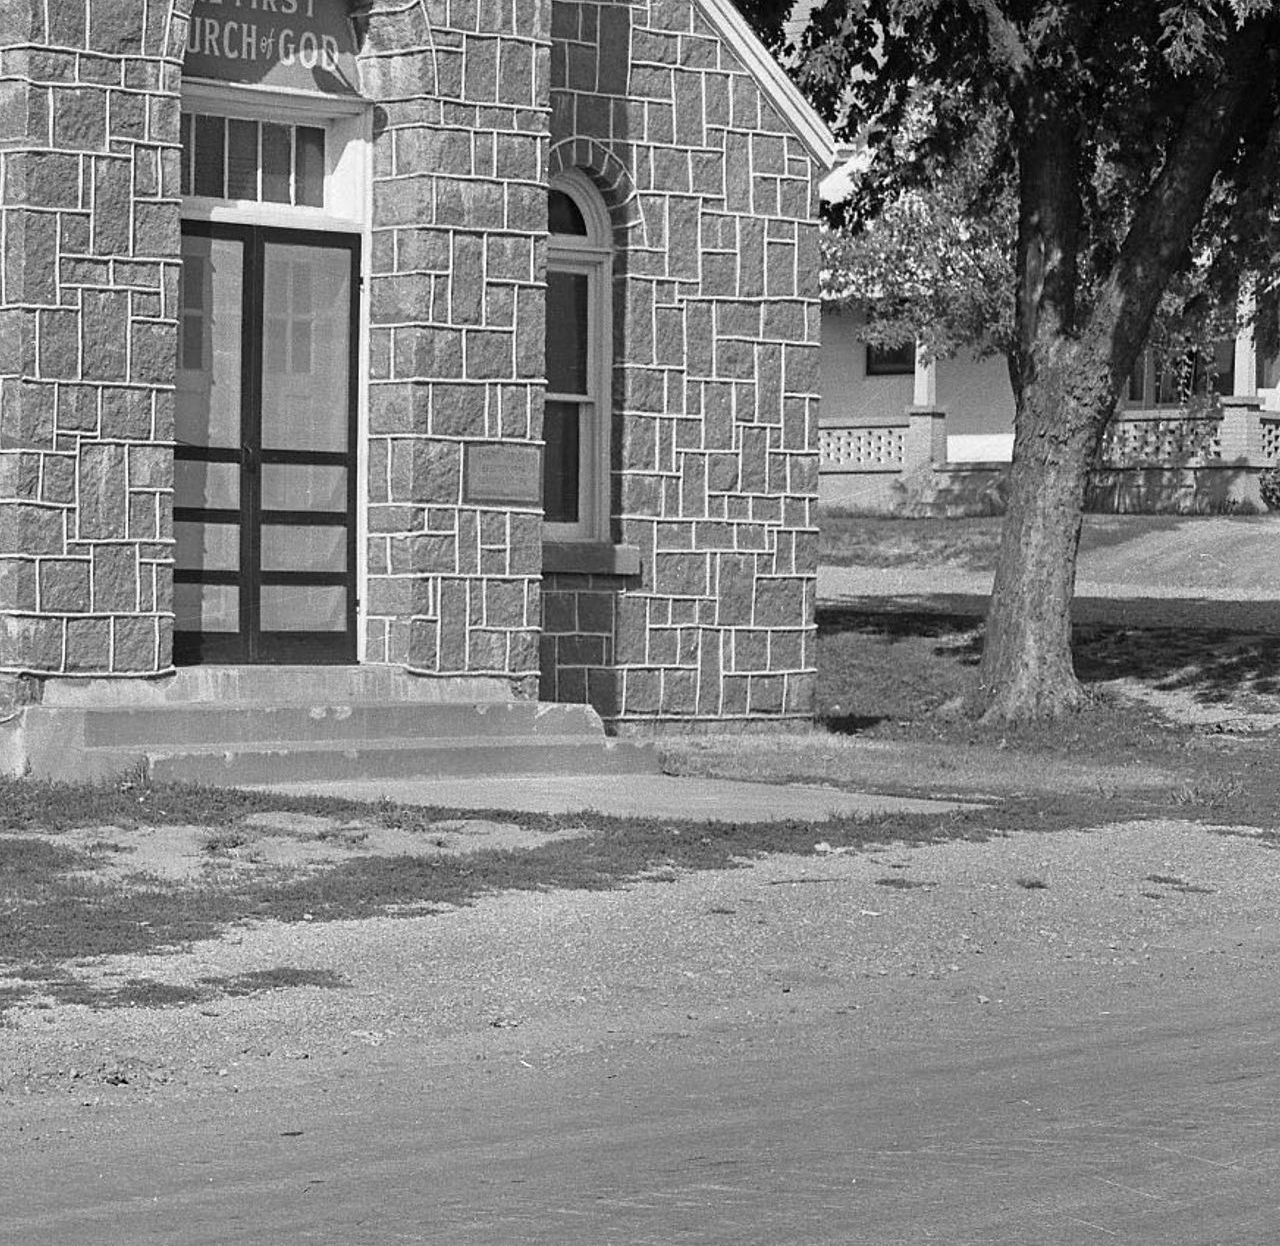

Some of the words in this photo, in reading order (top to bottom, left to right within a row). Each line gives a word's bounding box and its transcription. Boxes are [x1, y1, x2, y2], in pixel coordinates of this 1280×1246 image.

[186, 16, 257, 60] URCH
[259, 28, 275, 60] of
[278, 28, 339, 72] GOD
